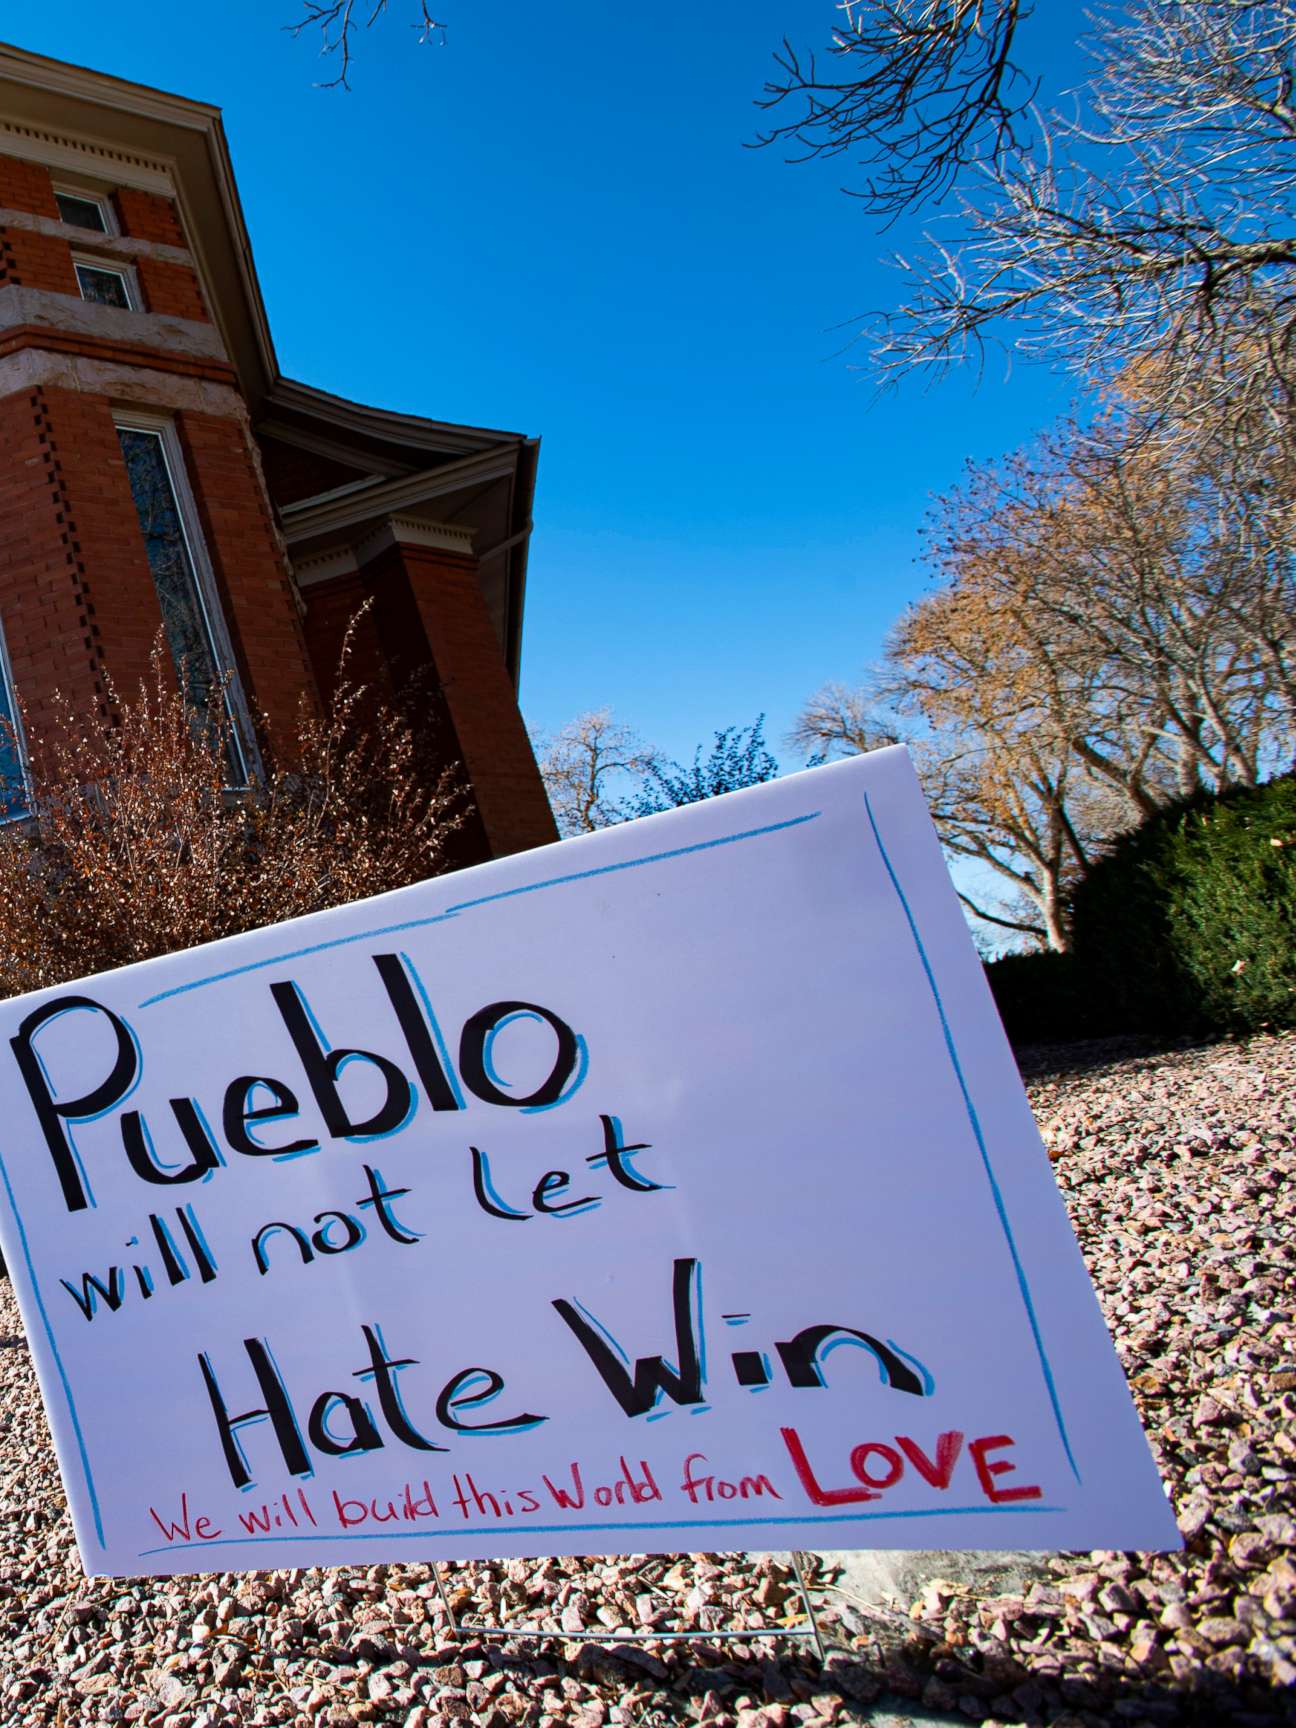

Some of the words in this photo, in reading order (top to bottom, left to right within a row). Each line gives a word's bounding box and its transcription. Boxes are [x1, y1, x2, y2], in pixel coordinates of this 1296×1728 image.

[8, 951, 589, 1212] Pueblo
[59, 1202, 219, 1322] will
[251, 1164, 427, 1276] not
[469, 1113, 677, 1221] let
[149, 1491, 223, 1542] We
[238, 1487, 318, 1534] will
[332, 1480, 439, 1529] build
[451, 1472, 541, 1520] this
[542, 1455, 662, 1510] World
[680, 1452, 784, 1505] from
[779, 1426, 1044, 1507] LOVE
[197, 1322, 549, 1493] Hate
[551, 1256, 936, 1422] Win
